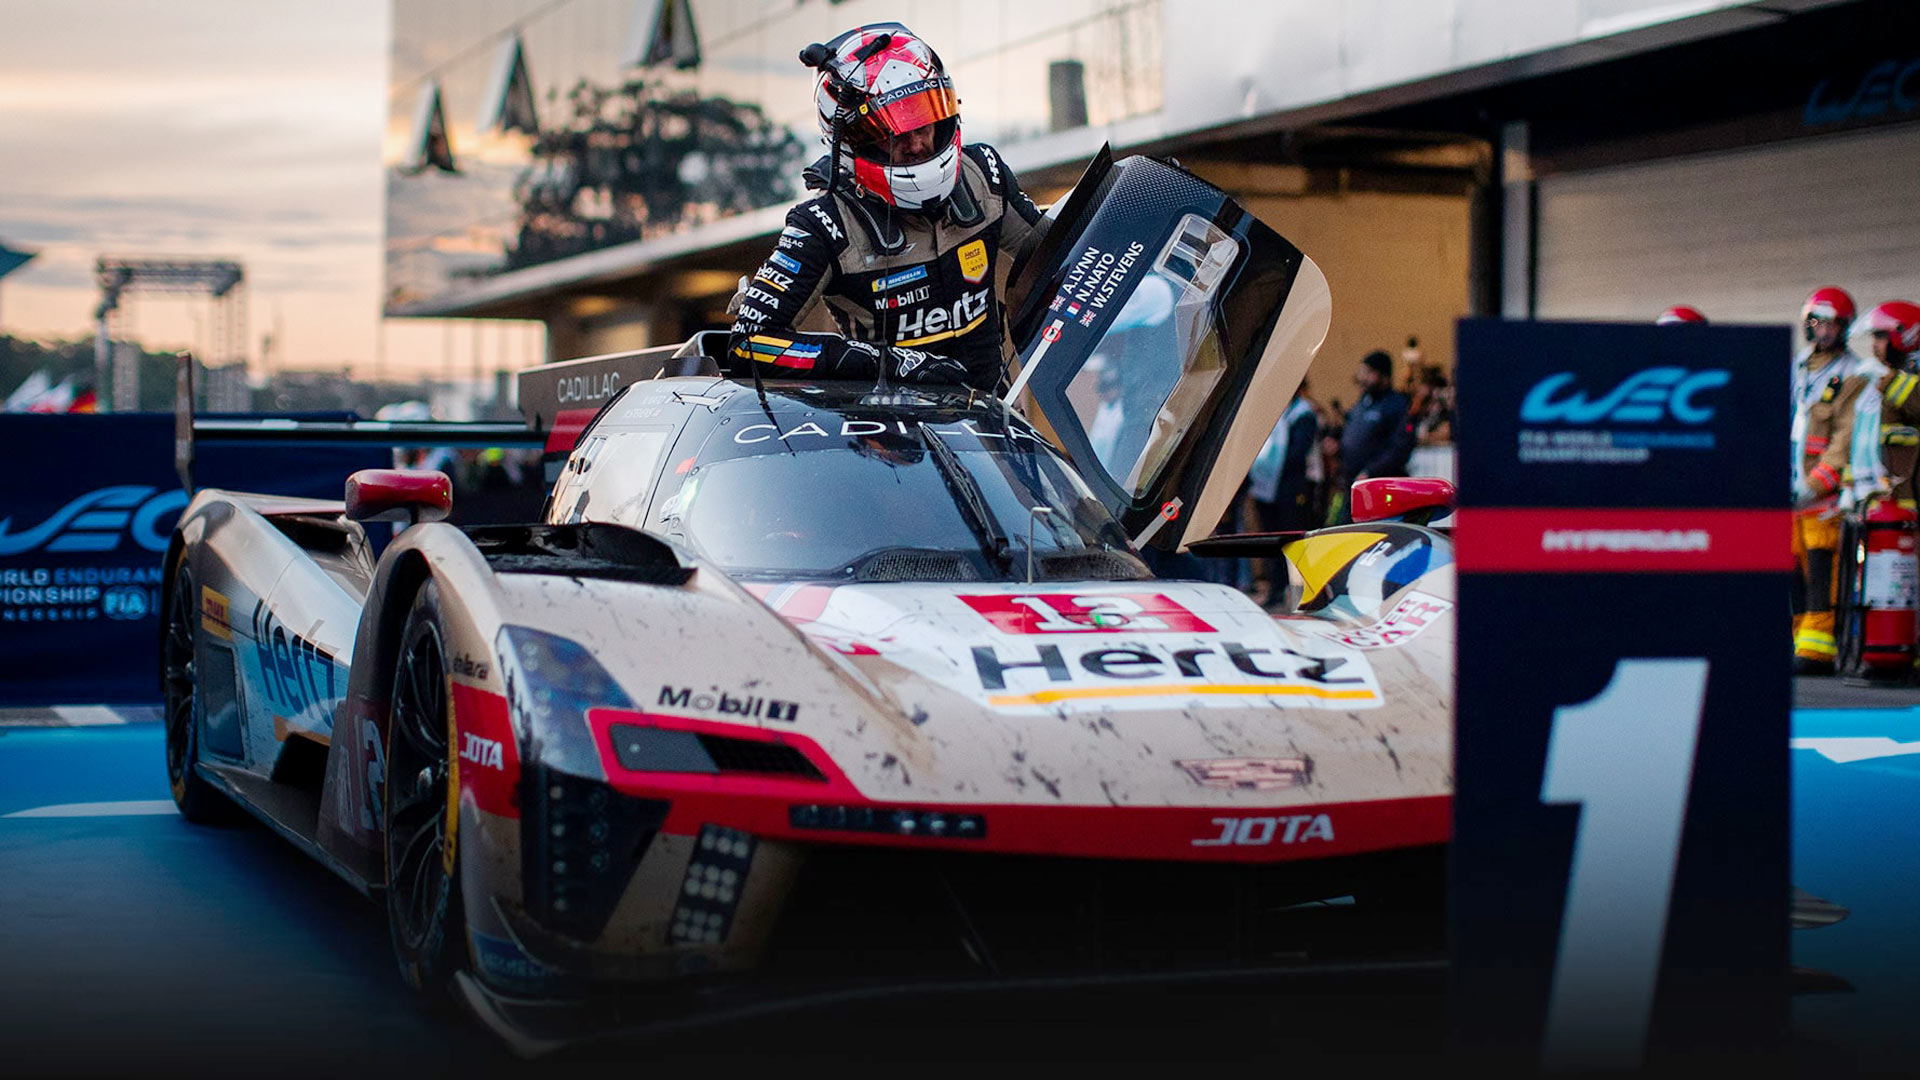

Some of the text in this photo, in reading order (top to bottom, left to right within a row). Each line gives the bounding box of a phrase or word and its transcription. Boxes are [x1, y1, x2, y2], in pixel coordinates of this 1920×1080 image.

[877, 80, 938, 105] CADILLAC
[808, 204, 844, 241] HRX
[888, 269, 922, 285] MICHELIN
[1062, 246, 1100, 295] A.LYNN
[1075, 252, 1115, 303] N.NATO
[1090, 241, 1144, 309] W.STEVENS
[875, 290, 915, 310] Mobil
[896, 287, 990, 341] Hertz
[557, 371, 621, 404] CADILLAC
[1519, 366, 1732, 423] WEC
[0, 568, 163, 585] RLD ENDURAN
[0, 586, 99, 604] IONSHIP
[970, 642, 1365, 690] Hertz
[657, 684, 763, 717] Mobil
[459, 731, 504, 771] JOTA
[1191, 814, 1335, 846] JOTA
[1539, 656, 1710, 1070] 1
